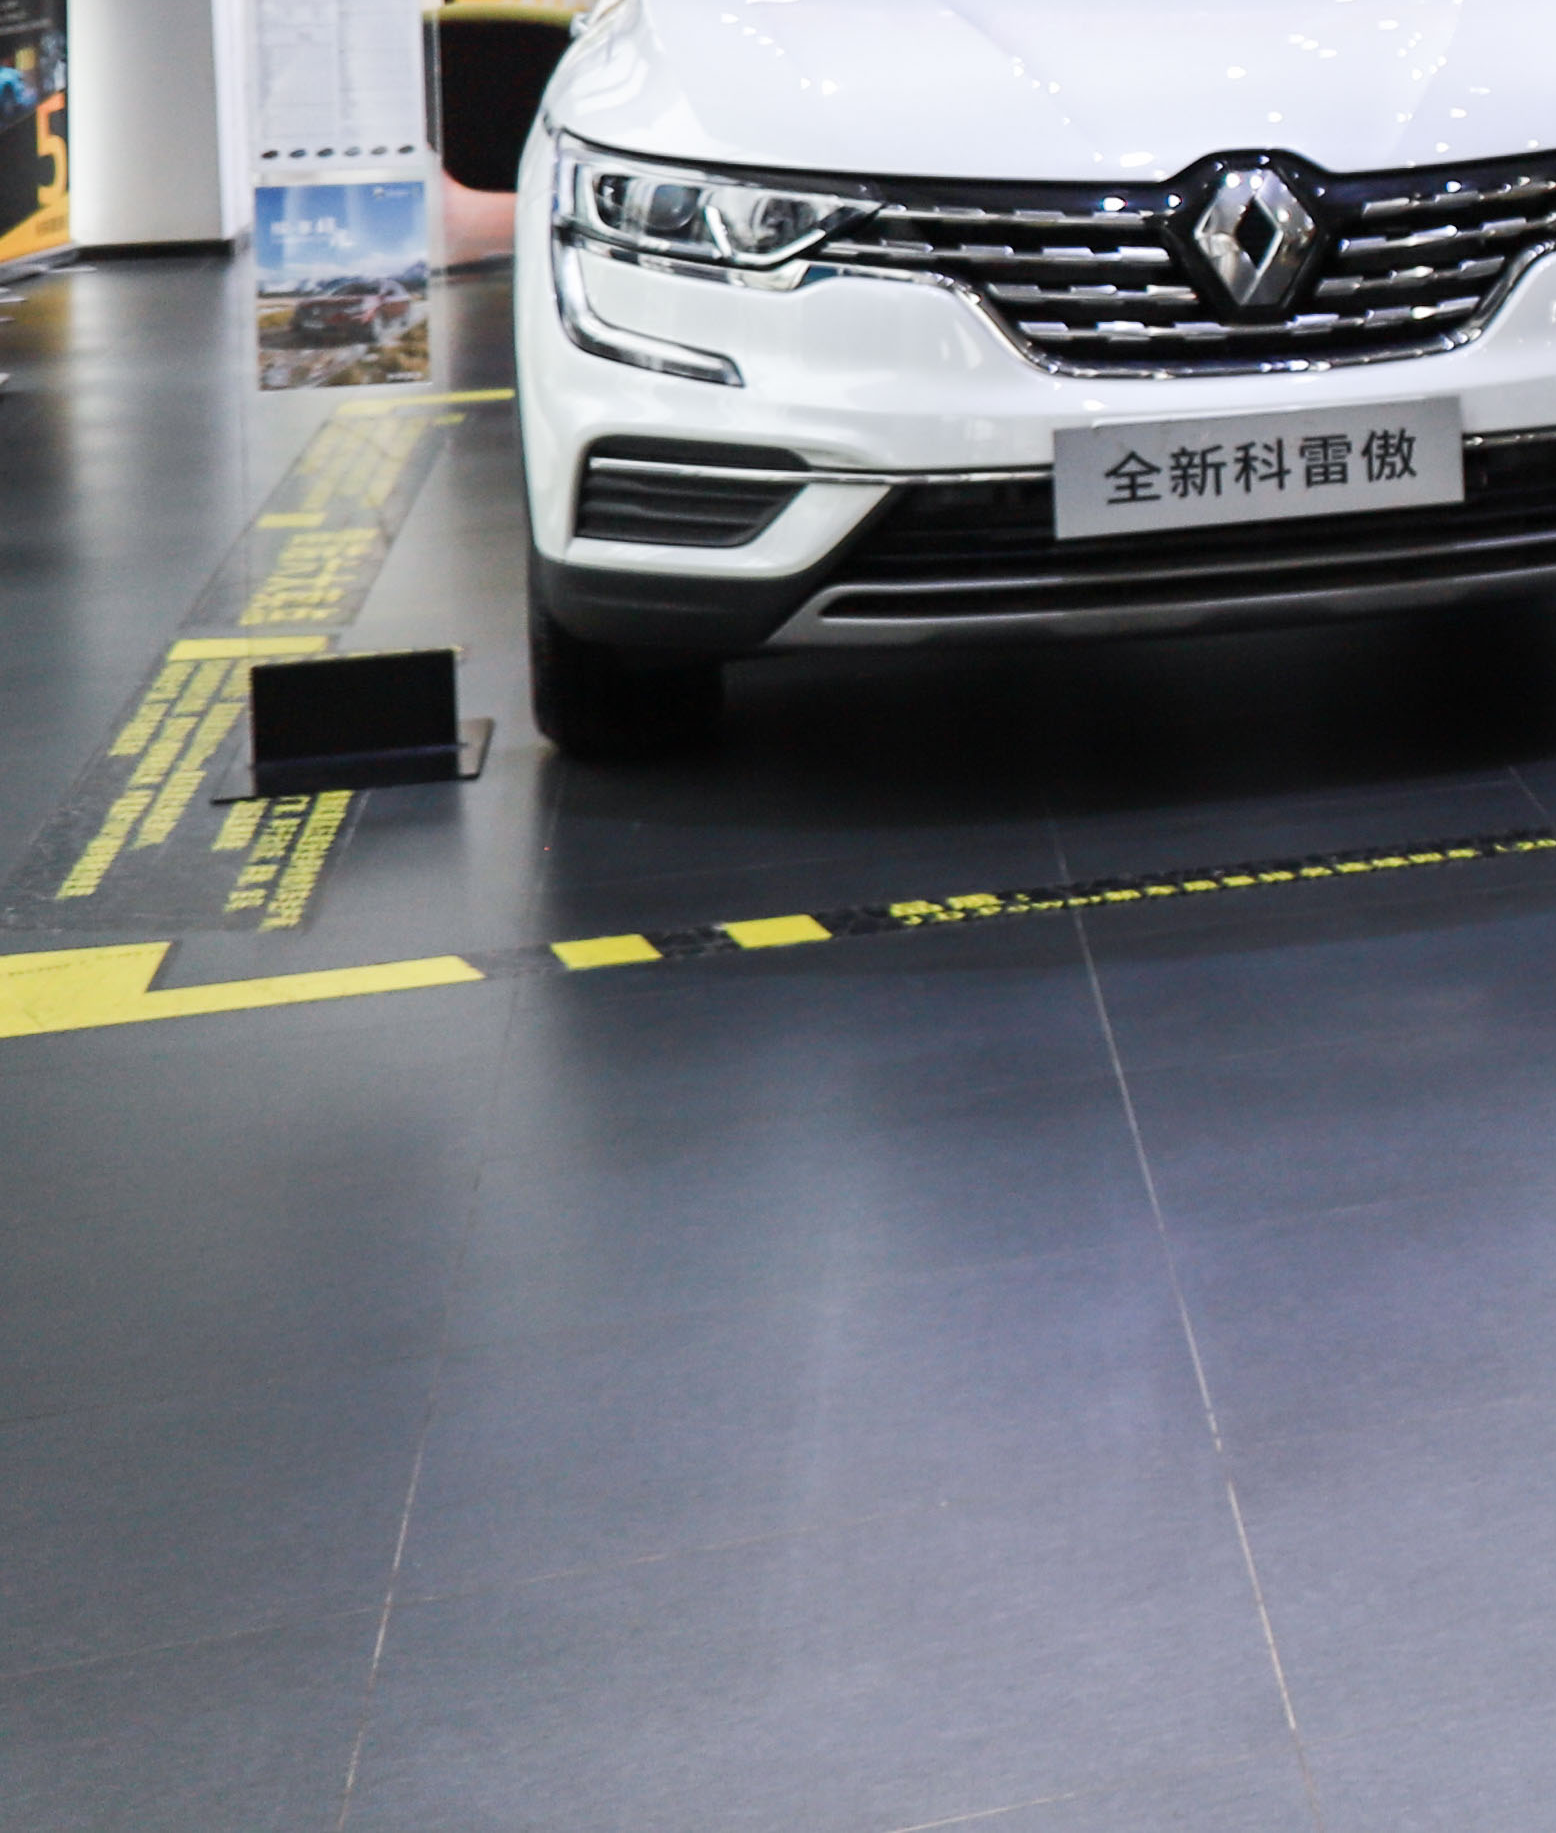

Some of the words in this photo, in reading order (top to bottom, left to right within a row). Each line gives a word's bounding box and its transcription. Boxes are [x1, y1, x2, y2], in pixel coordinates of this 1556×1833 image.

[1104, 426, 1418, 506] 全新科雷傲
